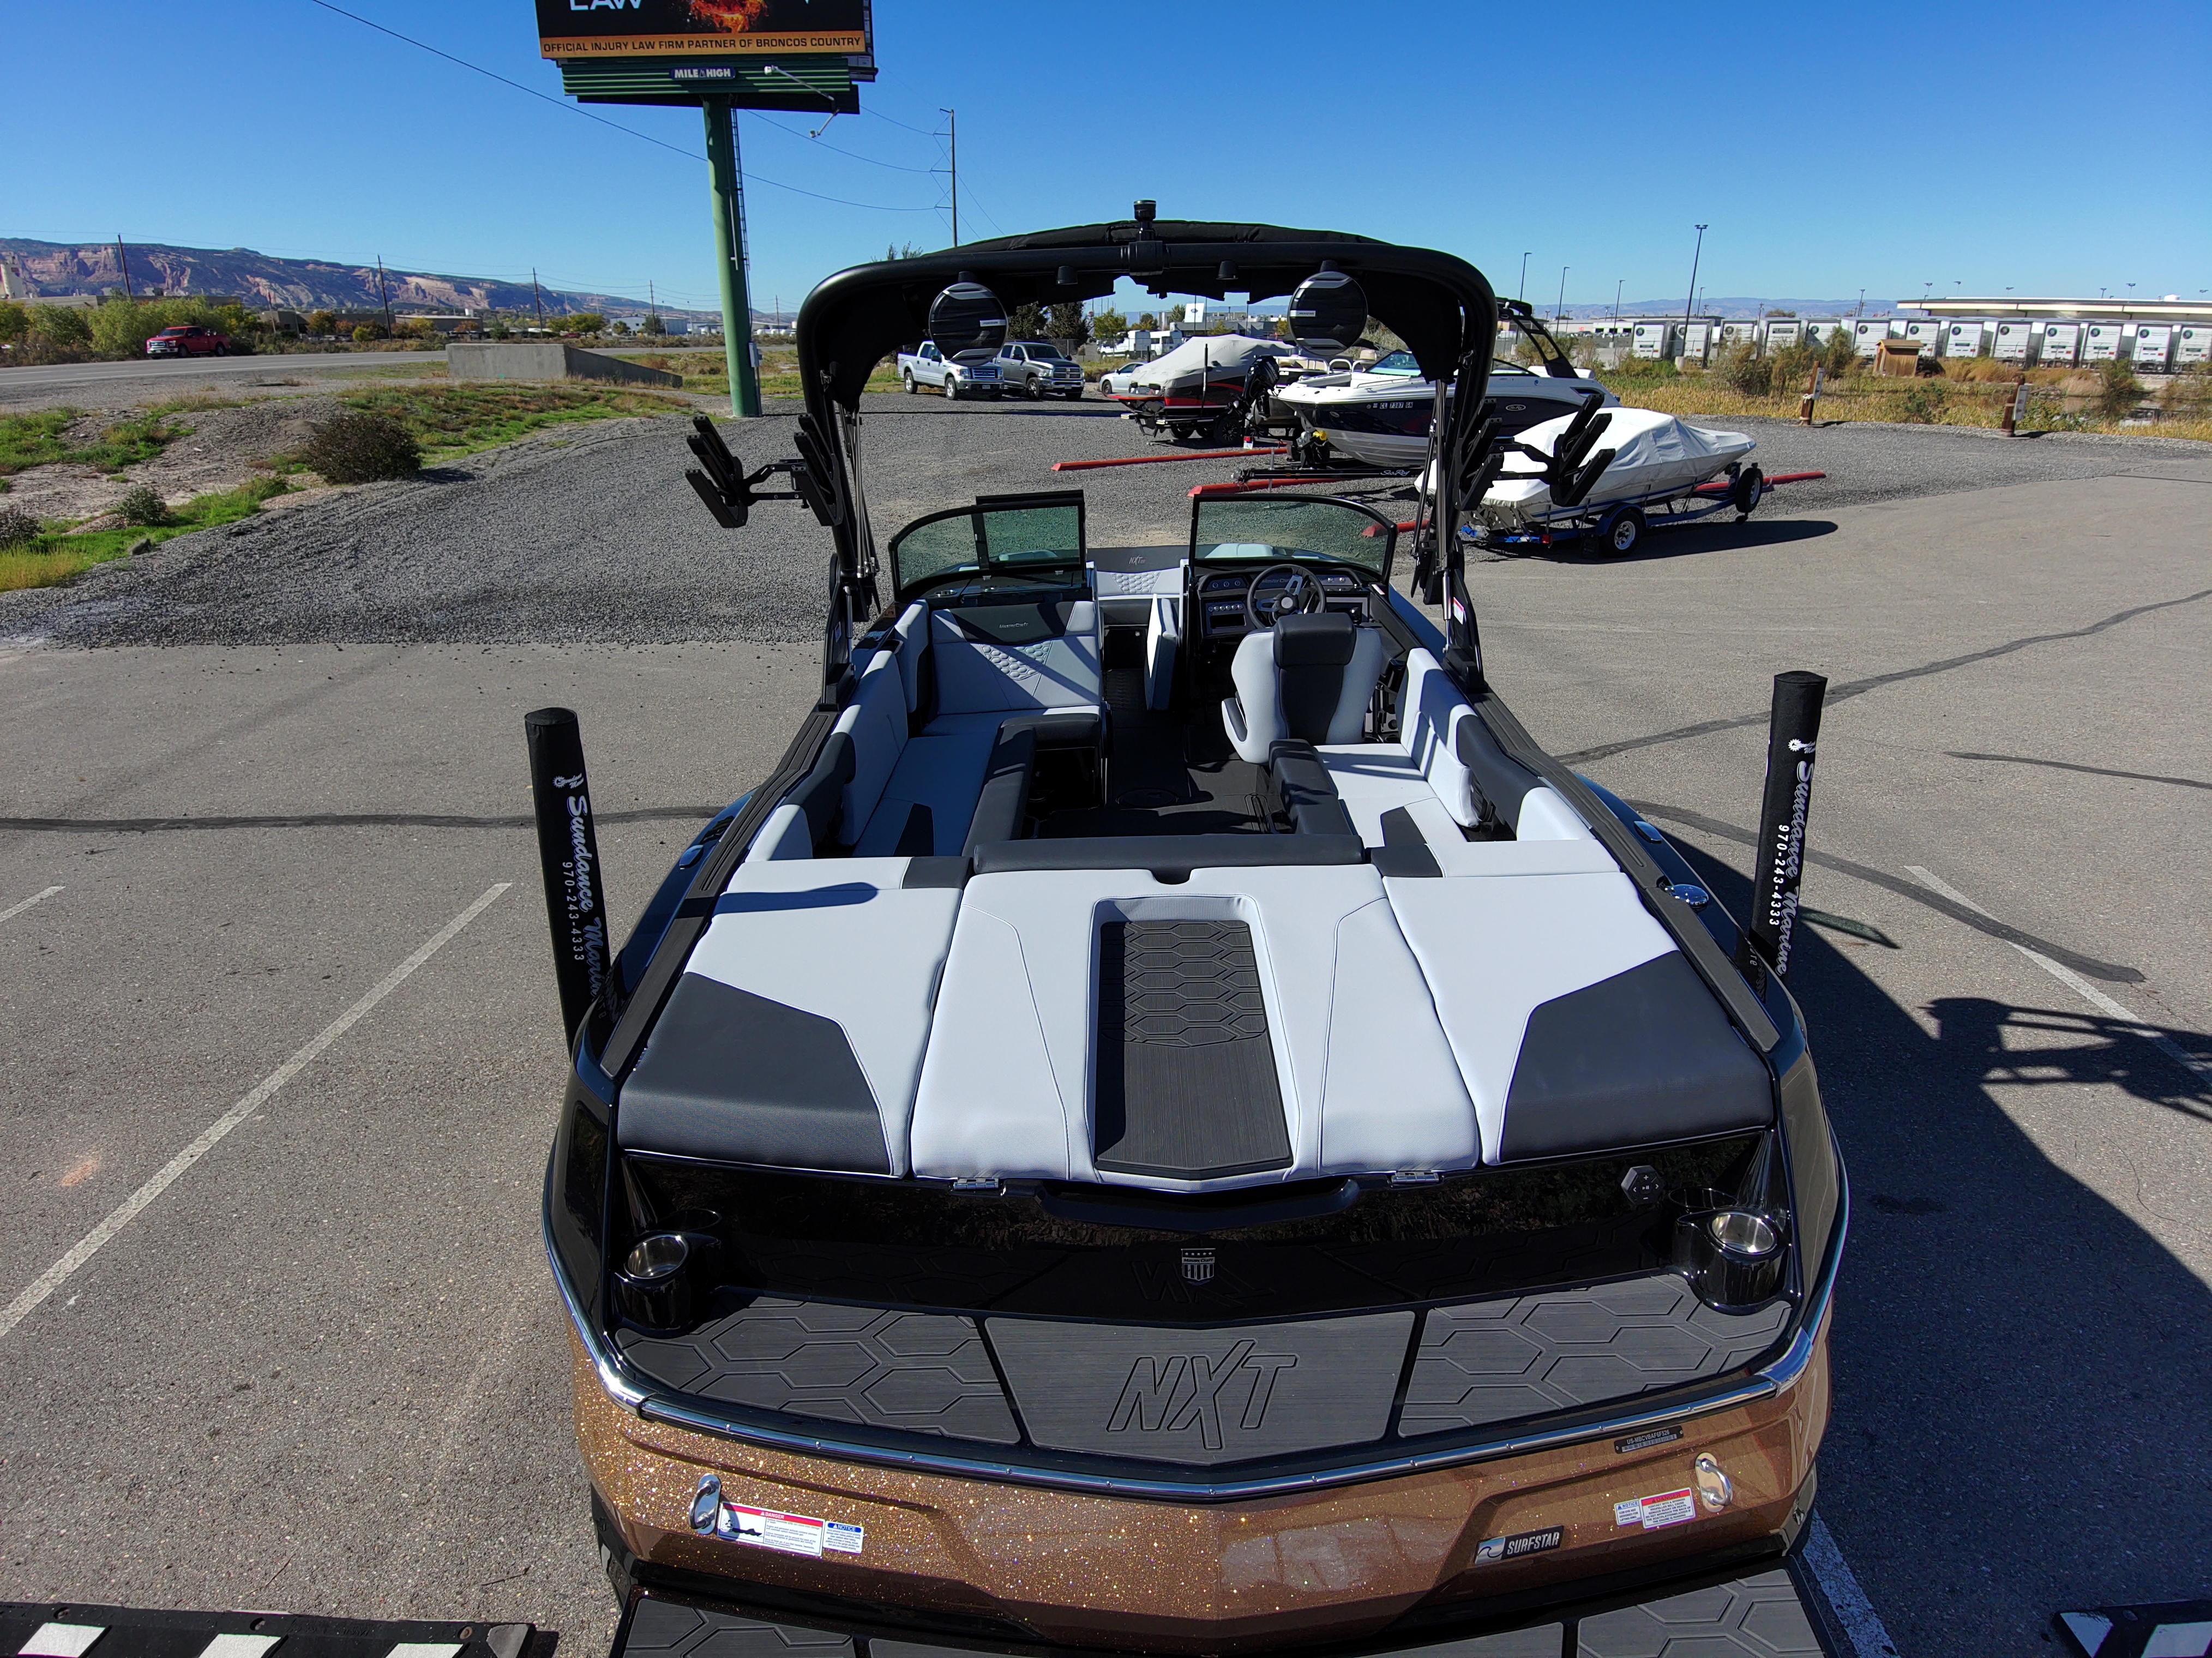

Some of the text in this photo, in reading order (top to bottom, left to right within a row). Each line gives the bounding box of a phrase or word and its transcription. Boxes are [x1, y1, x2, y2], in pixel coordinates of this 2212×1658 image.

[544, 37, 861, 52] OFFICIAL INJURY LAW FIRM PARTNER OF BRONCOS COUNTRY
[675, 68, 731, 78] MILE HIGH
[1129, 555, 1143, 566] NXT
[1786, 761, 1814, 879] Sundance
[562, 862, 585, 961] 970-243-4333
[567, 795, 594, 912] Sundance
[582, 917, 604, 999] Marin
[1769, 824, 1790, 926] 970-243-4333
[1775, 886, 1800, 977] Marine
[1106, 1338, 1300, 1451] NXT
[765, 1511, 784, 1519] DANGER
[1507, 1531, 1560, 1555] SURFSTAR
